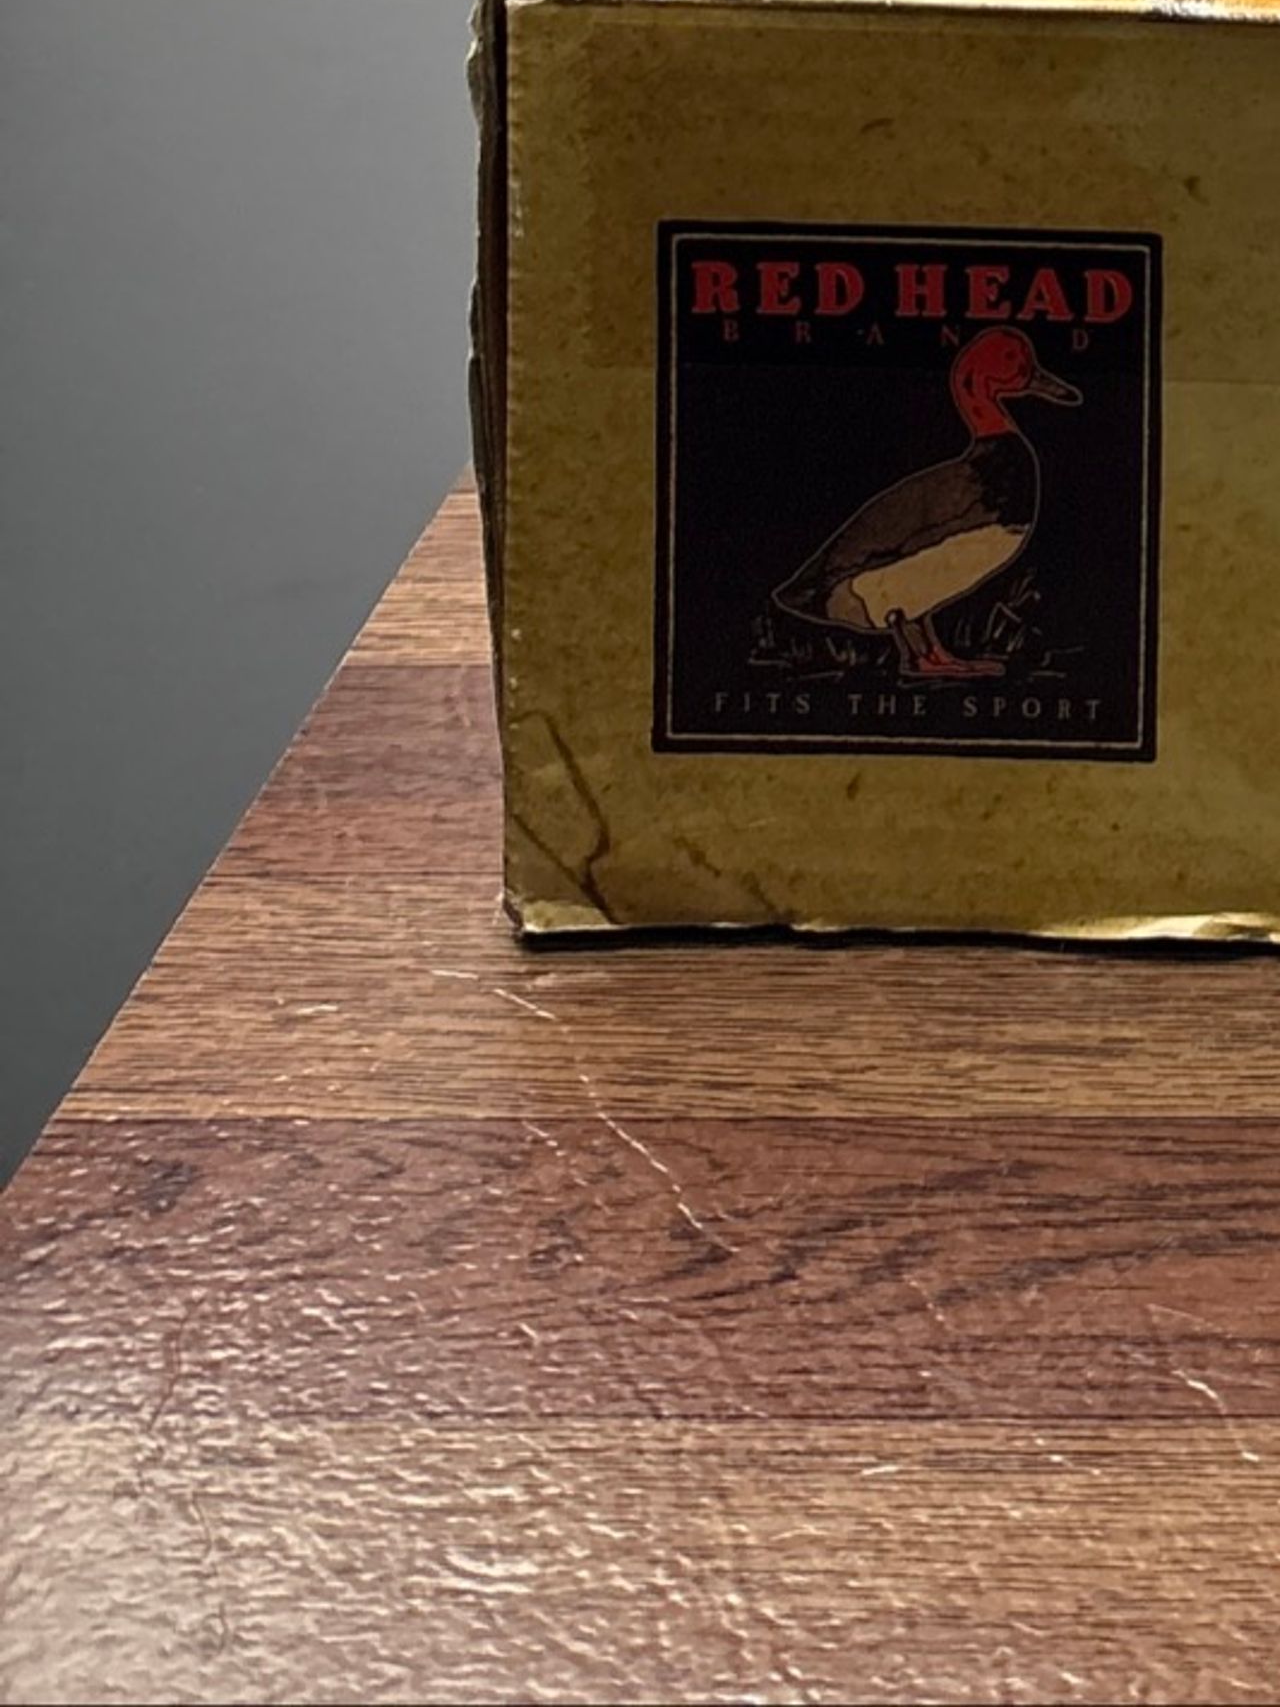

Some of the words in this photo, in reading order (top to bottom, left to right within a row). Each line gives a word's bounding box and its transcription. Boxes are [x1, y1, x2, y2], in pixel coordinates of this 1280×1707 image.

[690, 260, 867, 318] RED
[893, 263, 1137, 325] HEAD
[722, 319, 1092, 353] BRAND
[714, 690, 812, 714] FITS
[847, 693, 929, 716] THE
[963, 695, 1103, 721] SPORT
